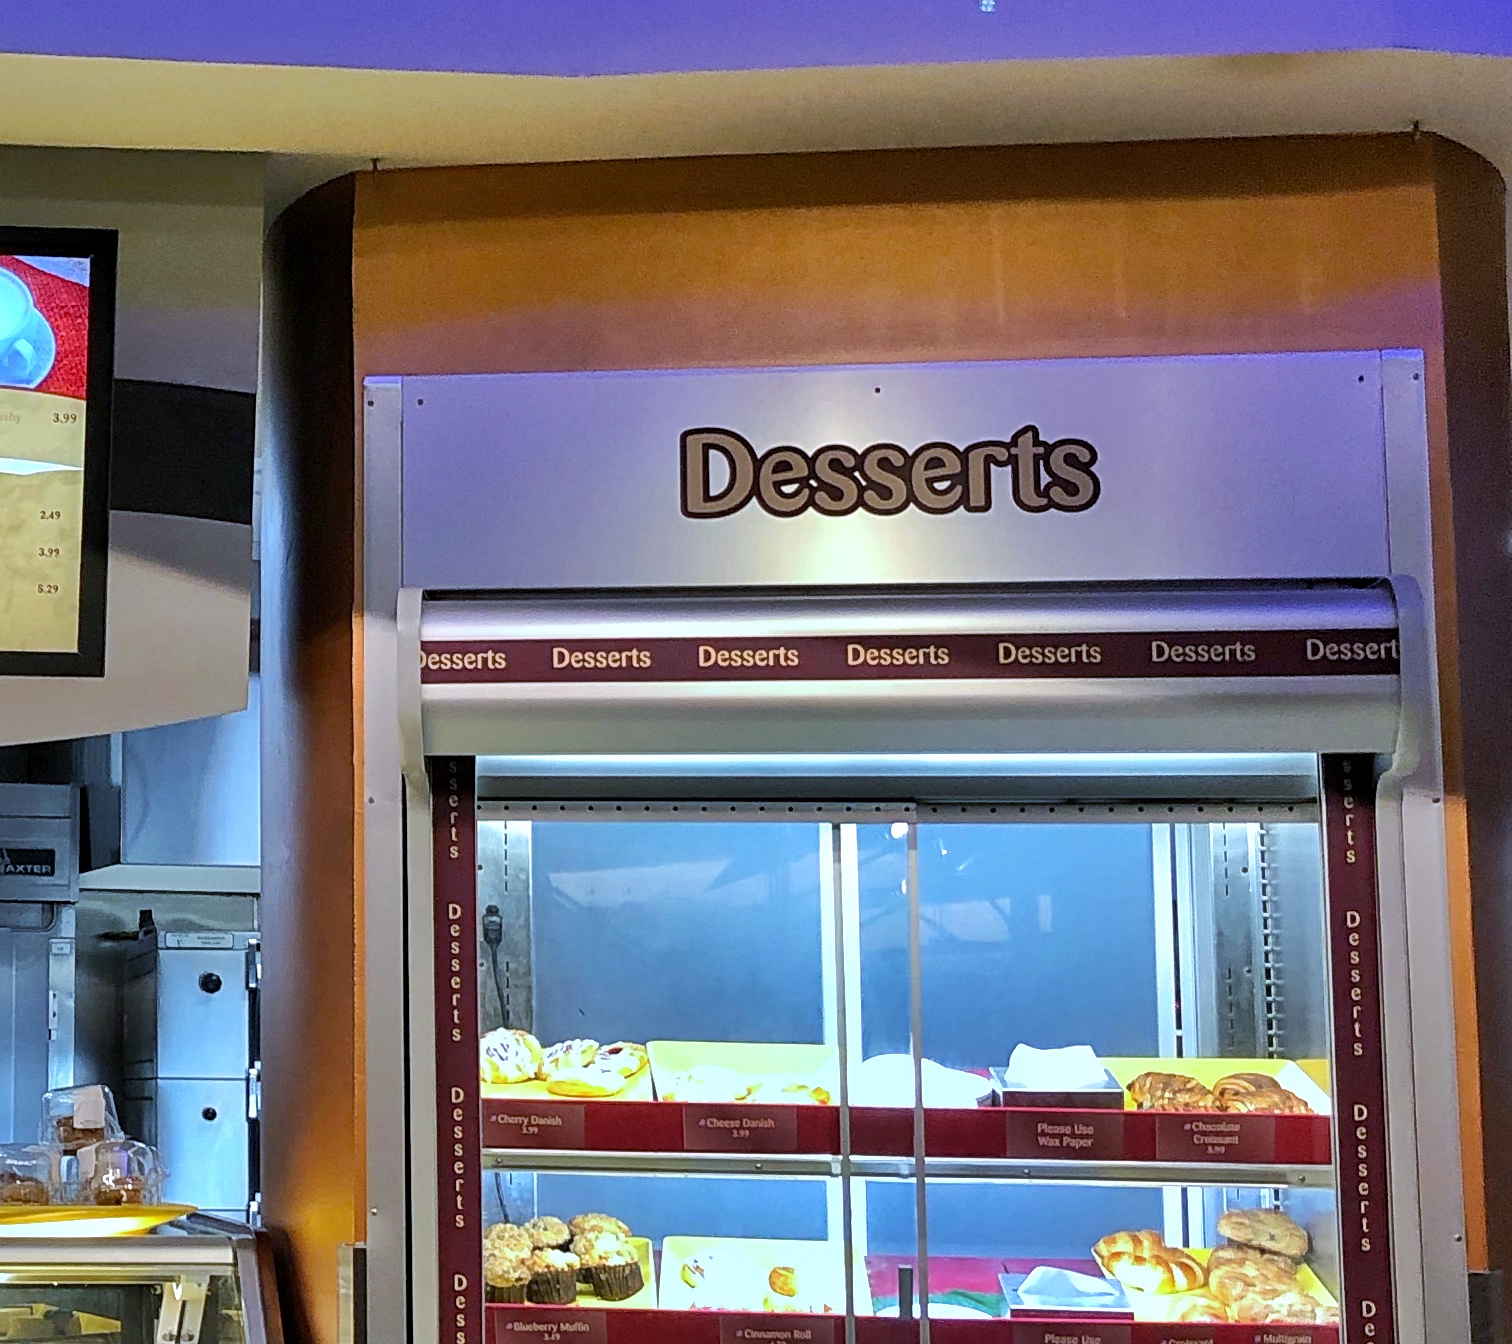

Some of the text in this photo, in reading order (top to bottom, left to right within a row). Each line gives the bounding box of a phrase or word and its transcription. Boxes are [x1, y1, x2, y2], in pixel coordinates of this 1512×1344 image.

[53, 413, 77, 424] 3.99
[679, 425, 1101, 520] Desserts
[39, 511, 61, 521] 2.49
[38, 547, 60, 557] 3.99
[553, 647, 651, 669] Desserts
[698, 645, 799, 668] Desserts
[847, 644, 949, 666] Desserts
[998, 642, 1102, 664] Desserts
[1151, 640, 1256, 663] Desserts
[448, 904, 462, 1042] Desserts
[1346, 910, 1364, 1056] Desserts
[498, 1114, 562, 1125] Cherry Danish
[706, 1117, 775, 1128] Cheese Danish
[1037, 1122, 1094, 1135] Please Use
[1192, 1122, 1240, 1132] Chocolate
[1037, 1136, 1094, 1149] Wax Paper
[451, 1086, 465, 1228] Desserts
[1353, 1104, 1371, 1253] Desserts
[513, 1322, 589, 1332] Blueberry Muffin
[744, 1329, 812, 1339] Cinnamon Roll
[1044, 1333, 1101, 1344] Please Use
[1263, 1334, 1312, 1344] Multigrain
